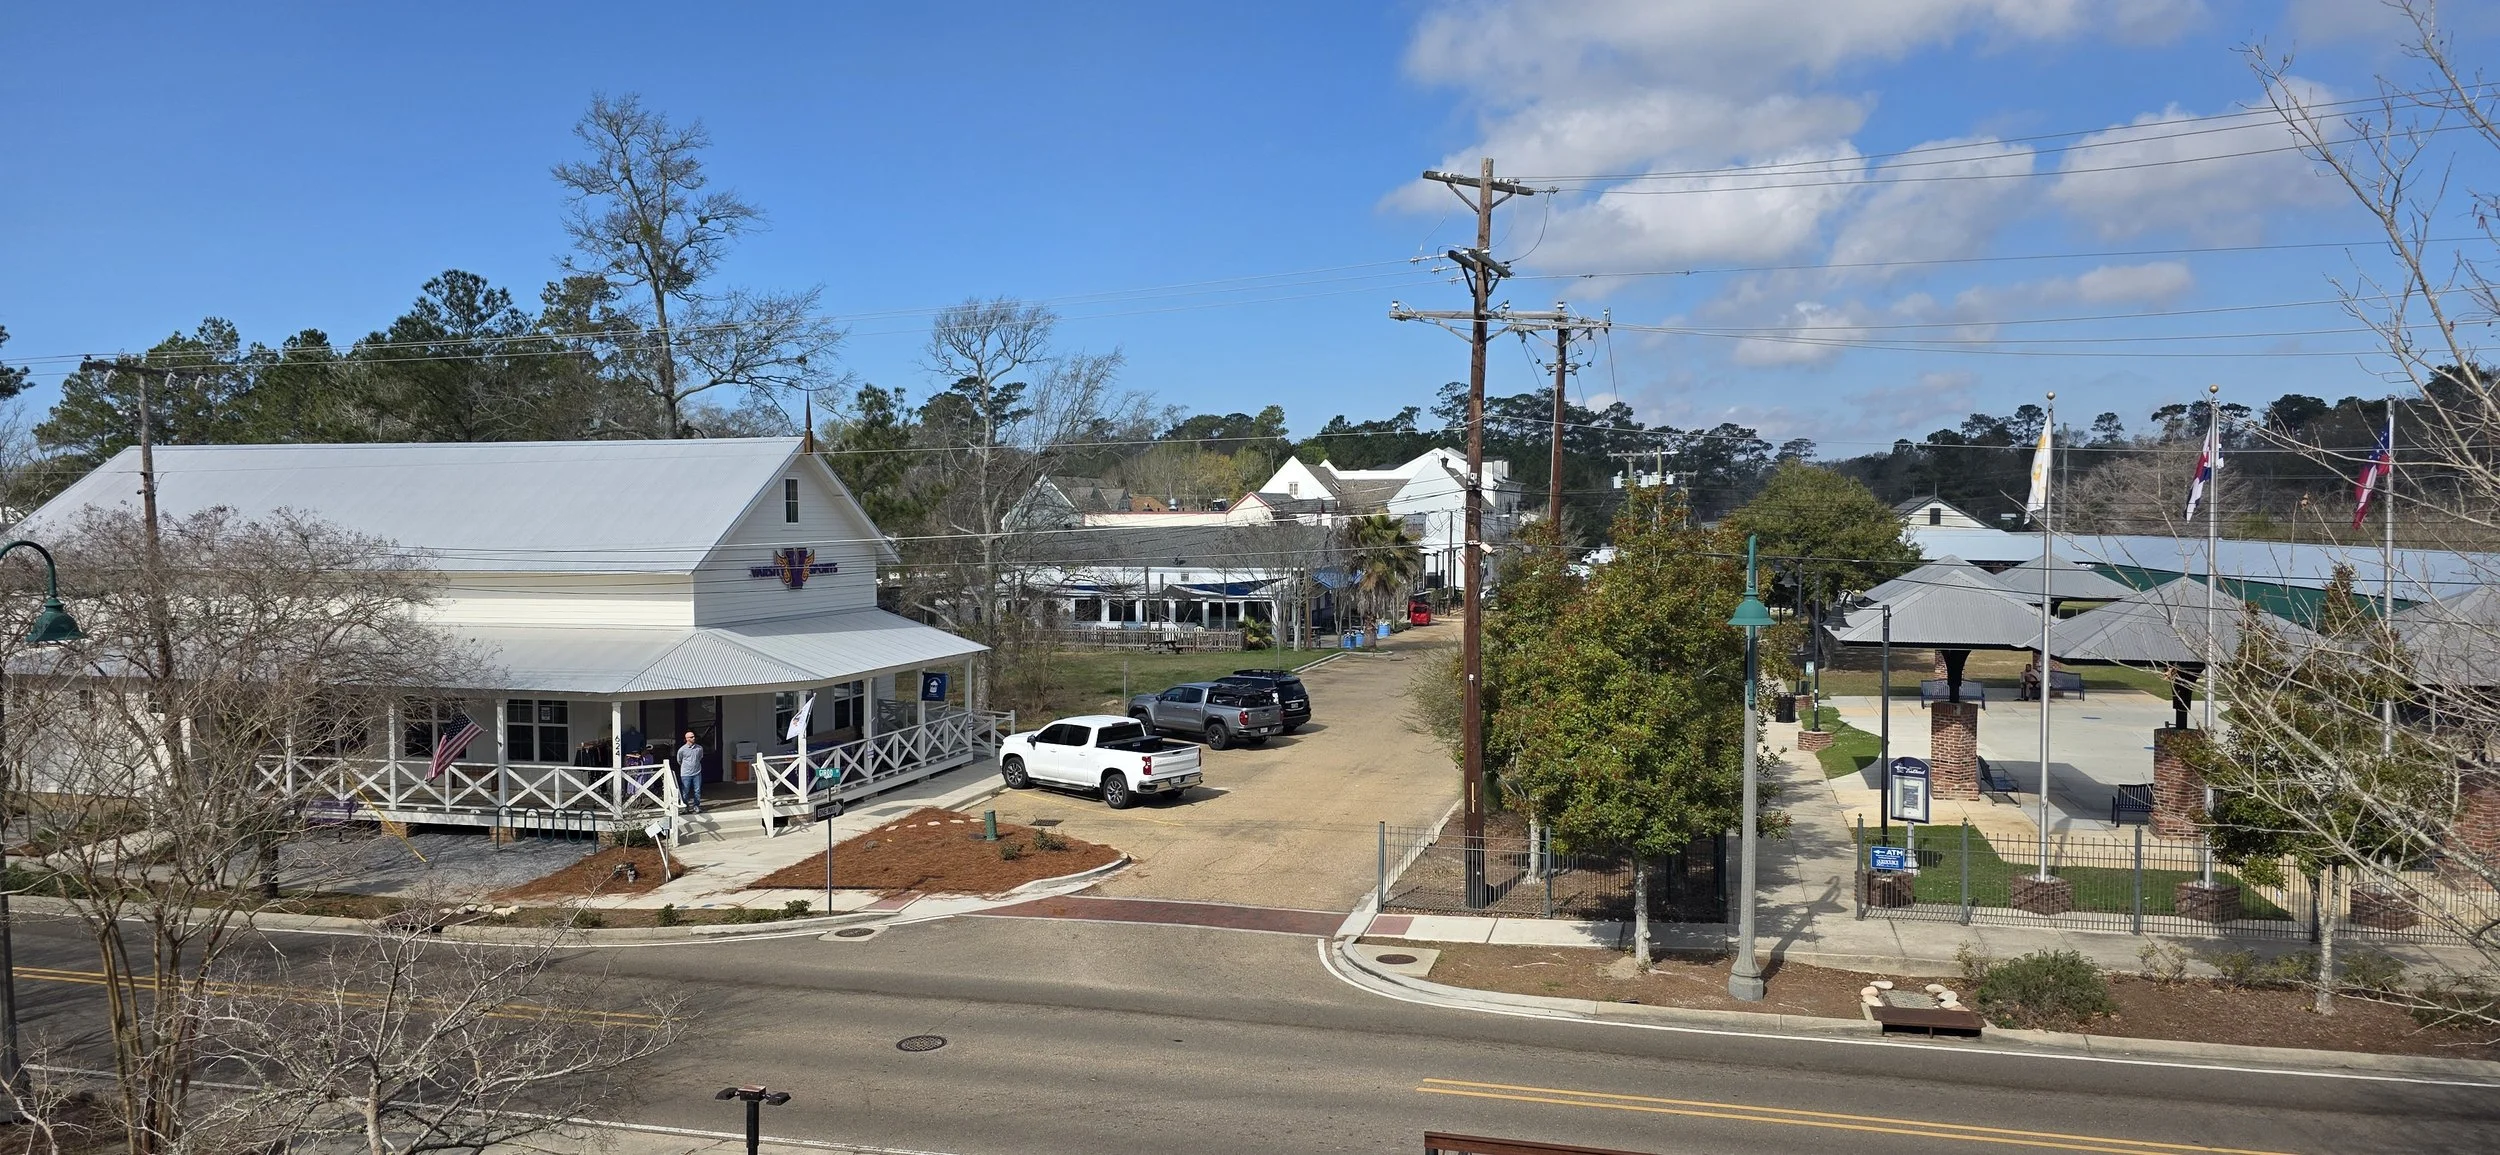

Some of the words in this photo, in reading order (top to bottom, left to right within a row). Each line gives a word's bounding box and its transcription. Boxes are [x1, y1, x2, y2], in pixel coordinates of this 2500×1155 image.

[809, 562, 838, 574] SPORTS
[818, 807, 828, 816] ONE
[828, 805, 836, 814] WAY
